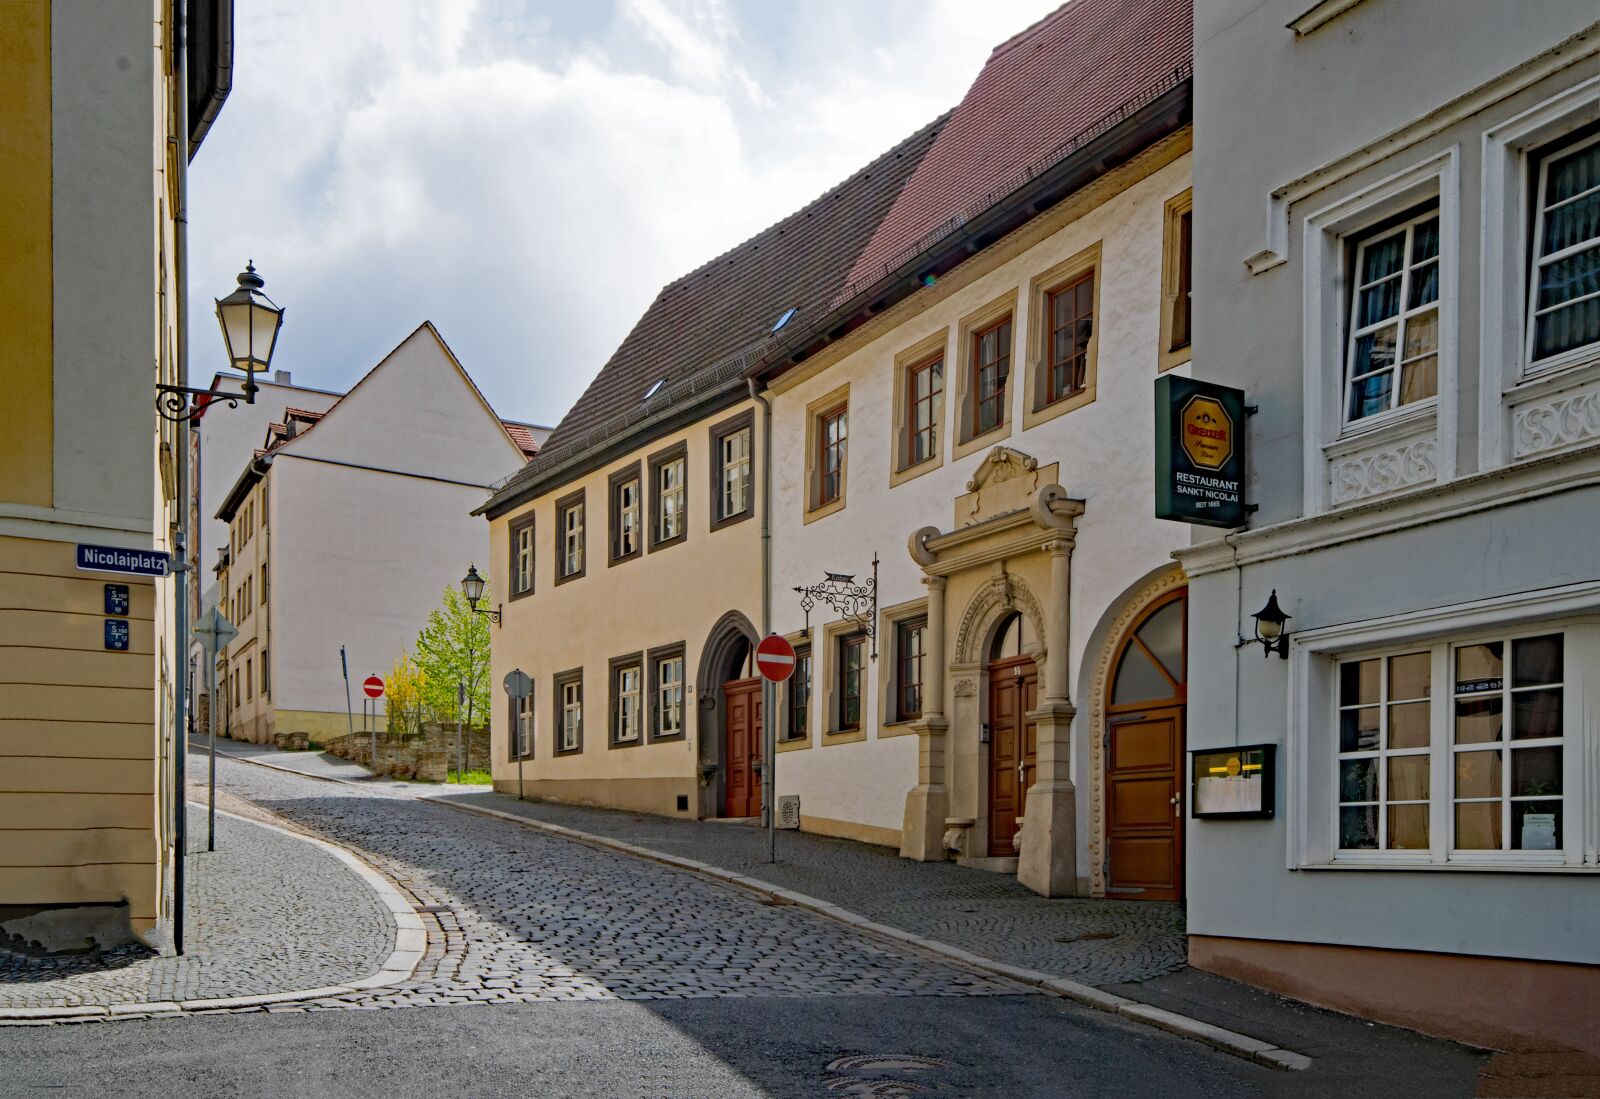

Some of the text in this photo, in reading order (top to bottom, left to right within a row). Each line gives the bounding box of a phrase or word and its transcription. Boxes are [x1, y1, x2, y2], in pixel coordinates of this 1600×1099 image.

[1176, 472, 1238, 490] RESTAURANT
[1176, 485, 1238, 502] SANKT NICOLAI
[84, 548, 163, 570] Nicolaiplatz
